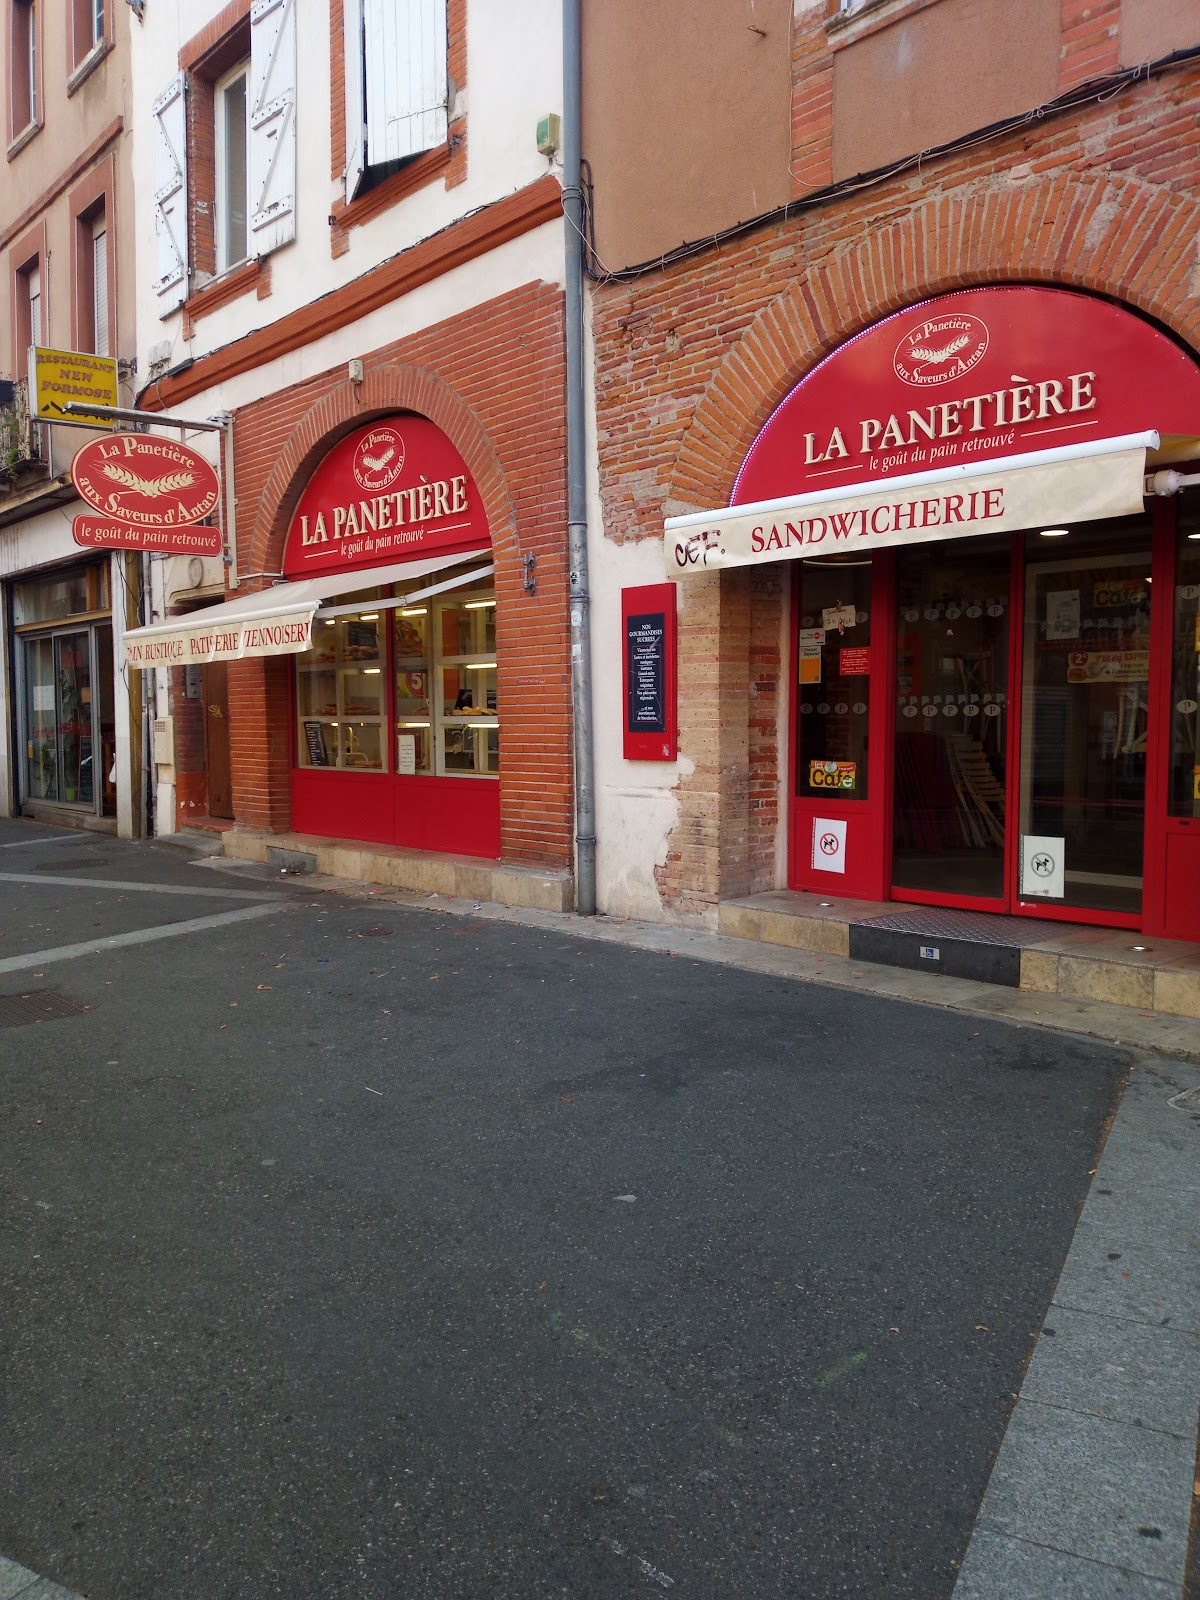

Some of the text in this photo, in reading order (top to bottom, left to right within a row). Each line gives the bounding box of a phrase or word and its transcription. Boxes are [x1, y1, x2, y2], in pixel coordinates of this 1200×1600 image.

[908, 317, 971, 345] La Panetière
[36, 354, 114, 373] RESTAURANT
[59, 369, 93, 382] NEW
[896, 342, 985, 384] aux Saveurs d'Antan
[41, 380, 112, 399] FORMOSE
[803, 371, 1097, 465] LA PANETIÈRE
[98, 437, 195, 469] La Panetière
[868, 428, 1015, 472] le goût du pain retrouvé
[79, 477, 216, 524] aux Saveurs d'Antan
[300, 474, 469, 546] LA PANETIÈRE
[81, 523, 216, 547] le goût du pain retrouvé
[751, 488, 1006, 553] SANDWICHERIE
[341, 525, 424, 558] le goût du pain retrouvé
[145, 640, 183, 662] RUSTIQUE
[812, 769, 852, 787] Café
